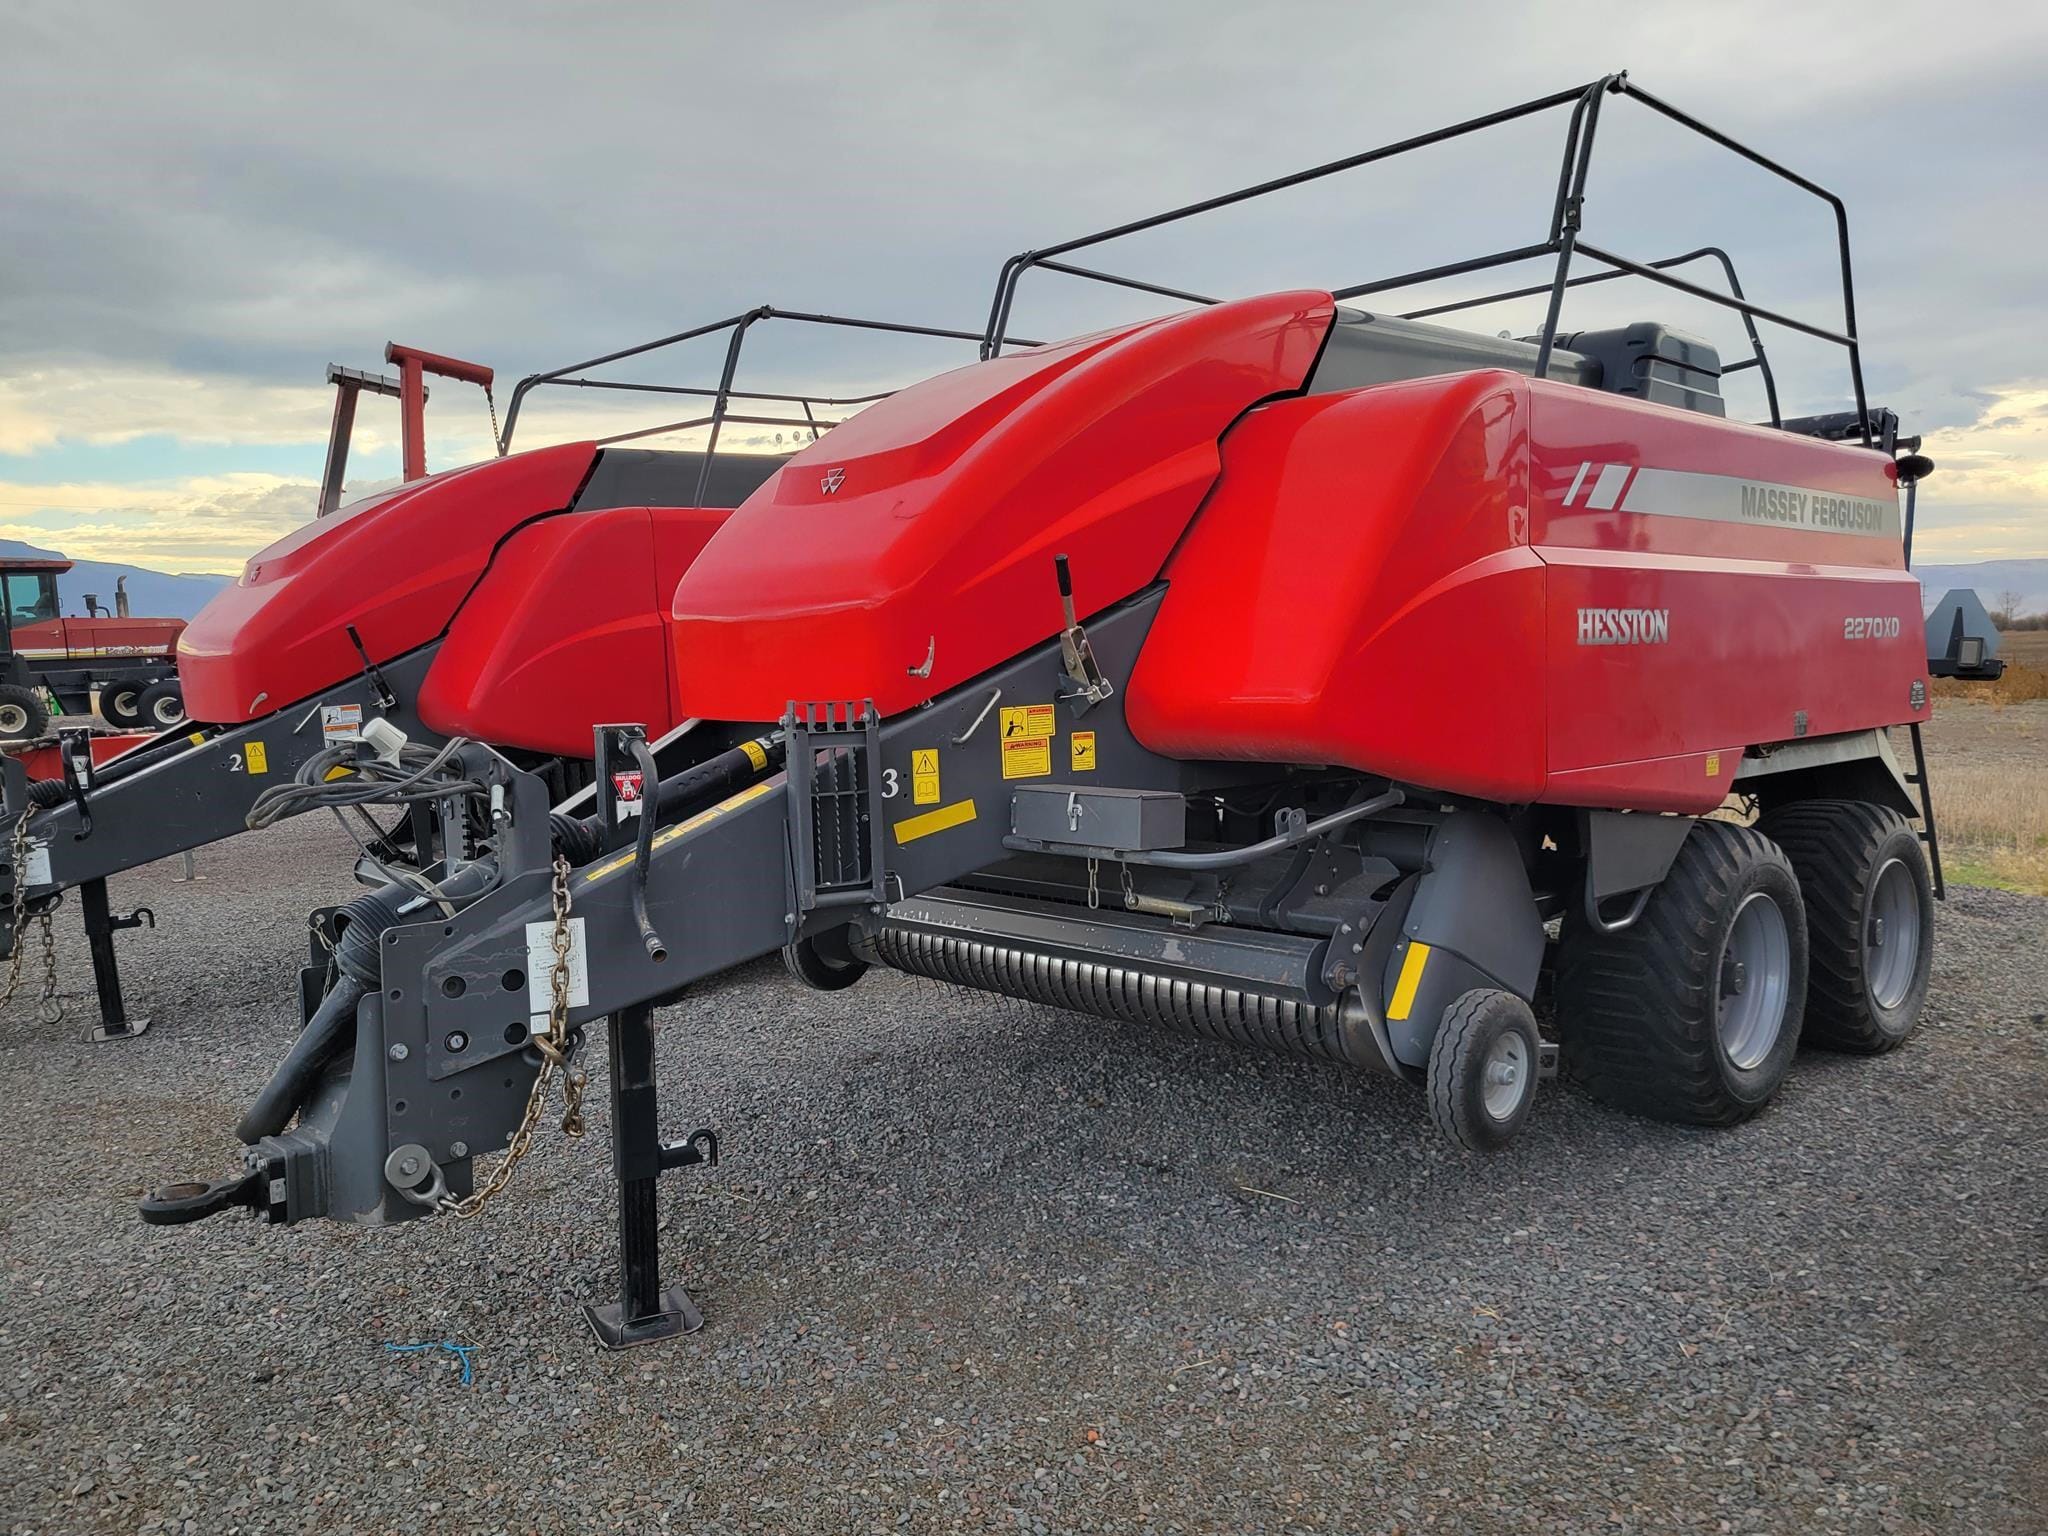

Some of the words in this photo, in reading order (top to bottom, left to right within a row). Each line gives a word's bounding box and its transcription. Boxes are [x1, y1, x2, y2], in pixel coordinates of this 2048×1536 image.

[1741, 485, 1807, 524] MASSEY
[1811, 495, 1883, 531] FERGUSON
[1577, 608, 1669, 646] HESSTON
[1844, 617, 1900, 639] 2270XD
[229, 753, 243, 772] 2
[881, 768, 899, 798] 3
